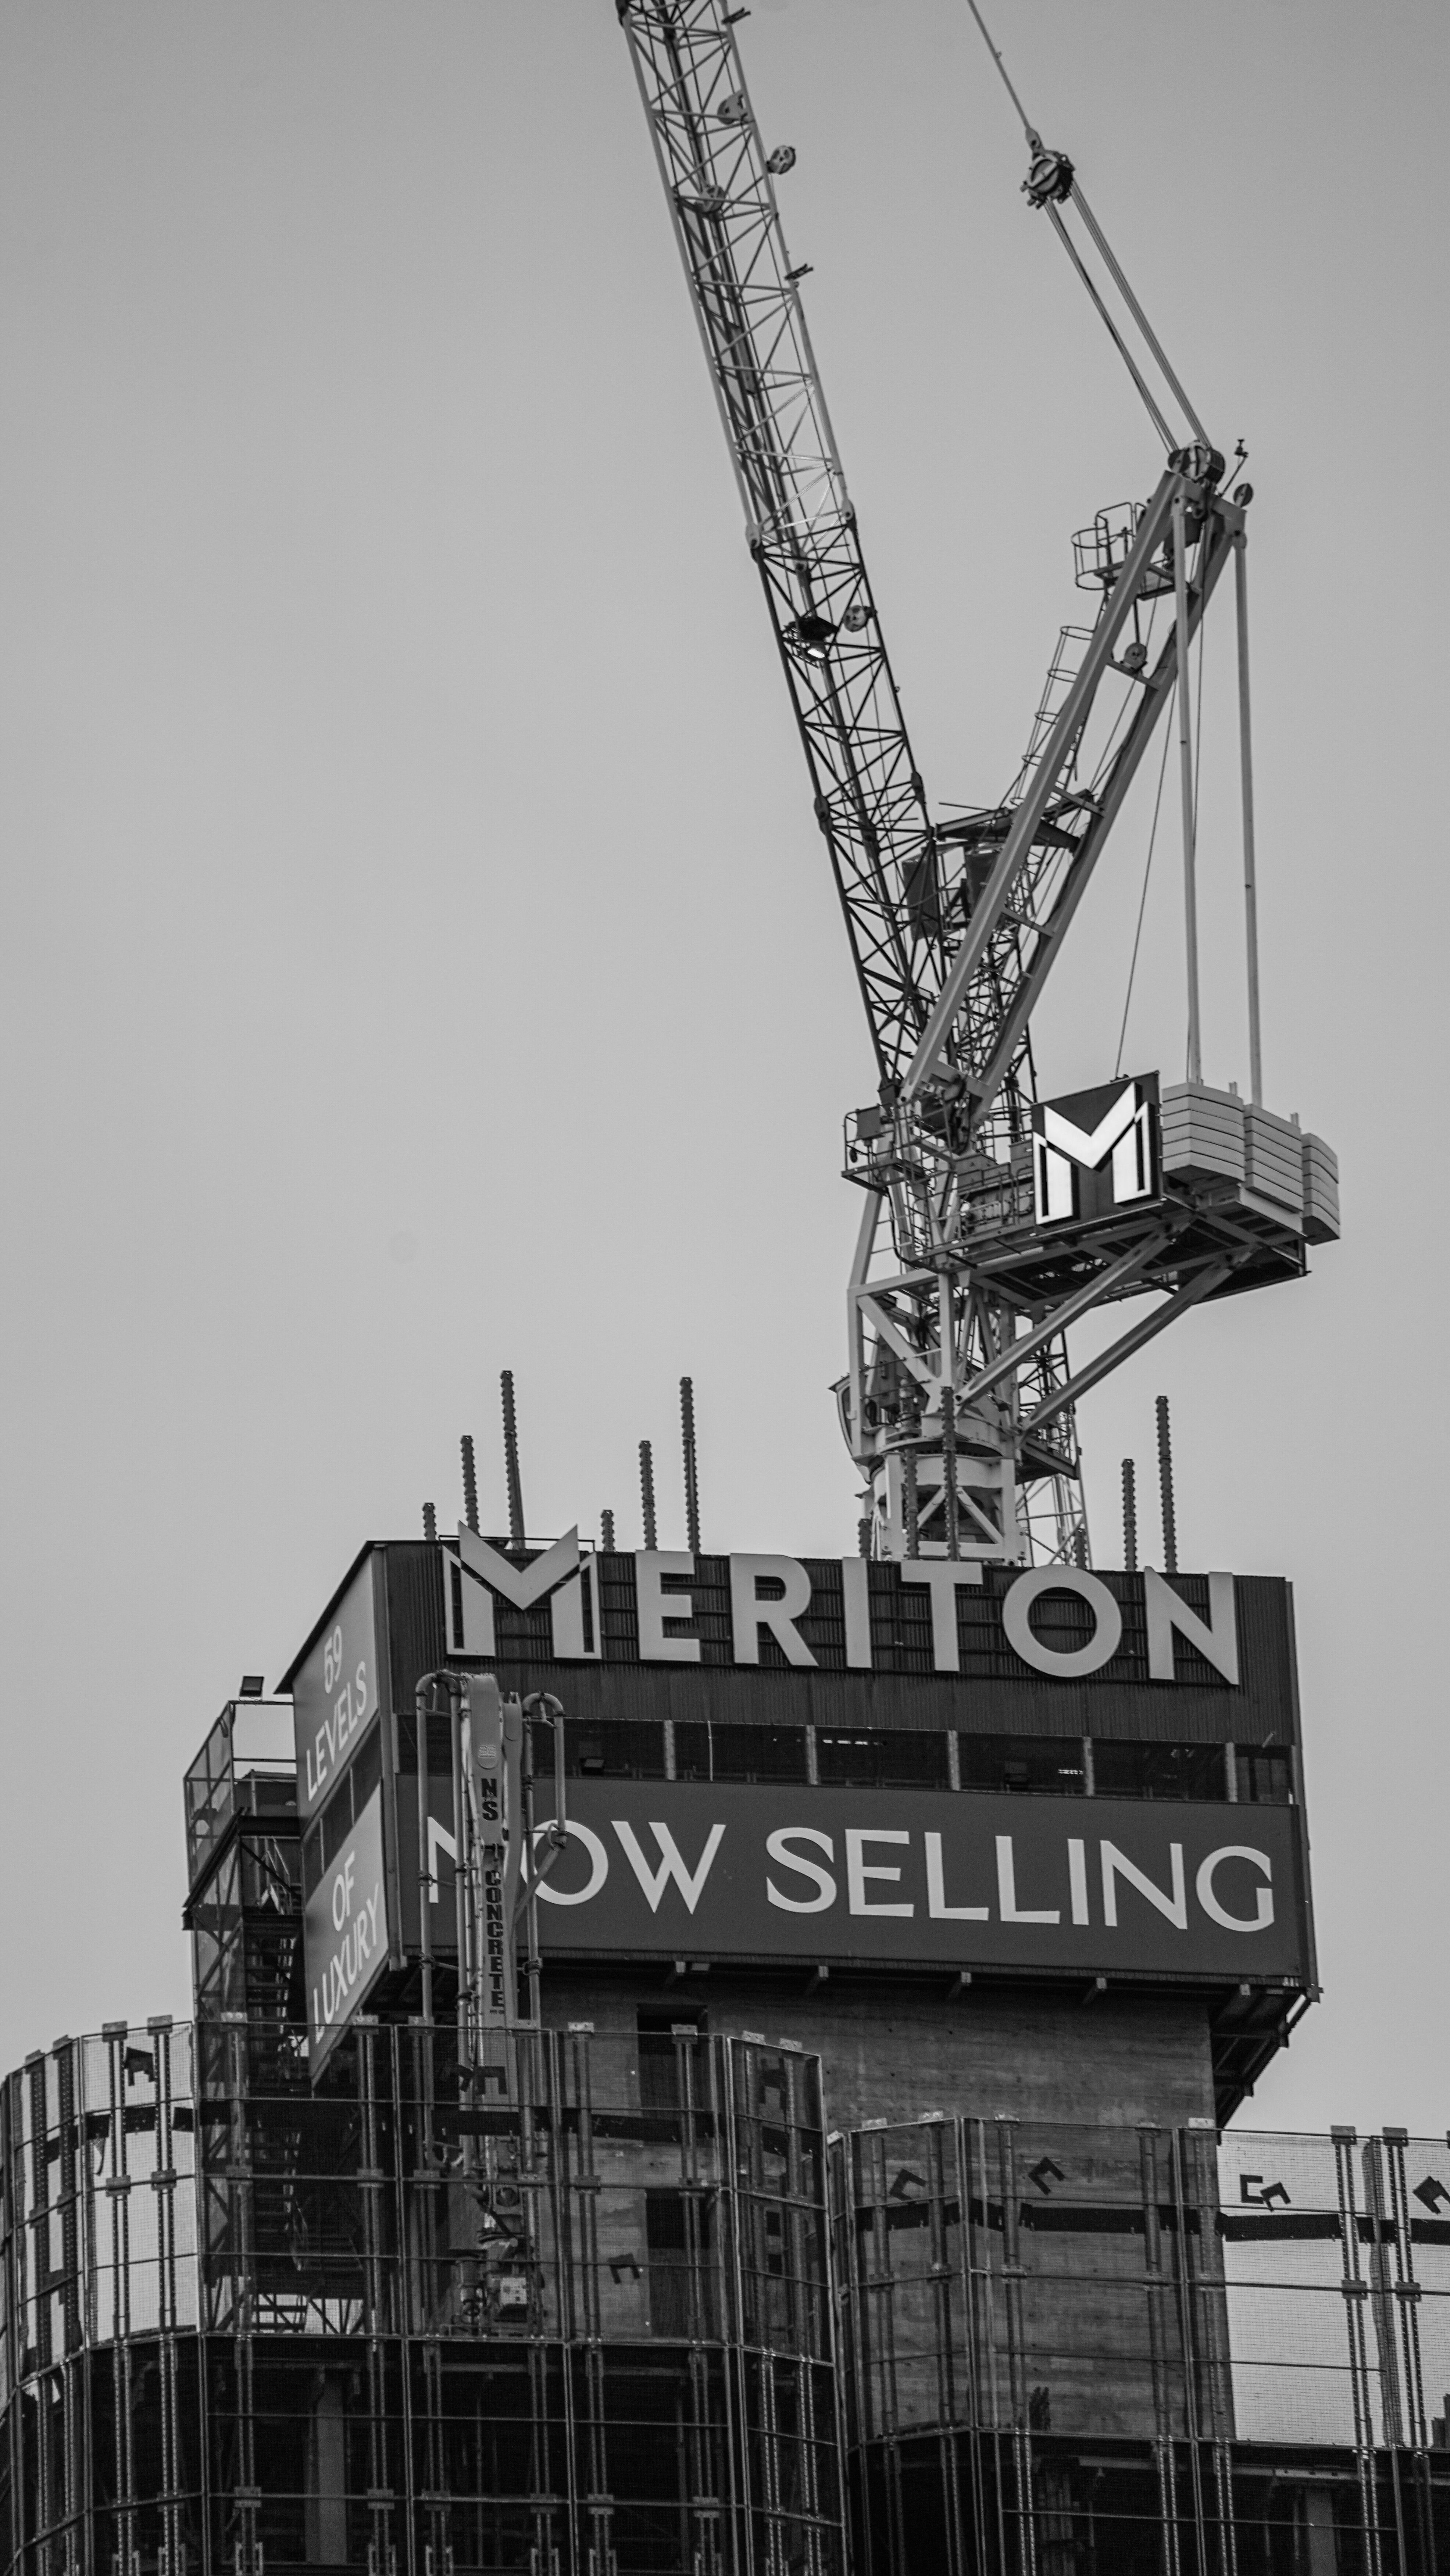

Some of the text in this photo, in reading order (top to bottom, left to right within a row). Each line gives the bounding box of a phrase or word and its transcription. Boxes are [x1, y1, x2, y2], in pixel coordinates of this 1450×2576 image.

[1033, 1082, 1151, 1224] M
[442, 1520, 1239, 1685] MERITON
[306, 1660, 367, 1802] LEVELS
[332, 1850, 355, 1932] OF
[485, 1870, 504, 2007] CONCRETE
[765, 1827, 1275, 1932] SELLING
[314, 1920, 379, 2044] LUXURY
